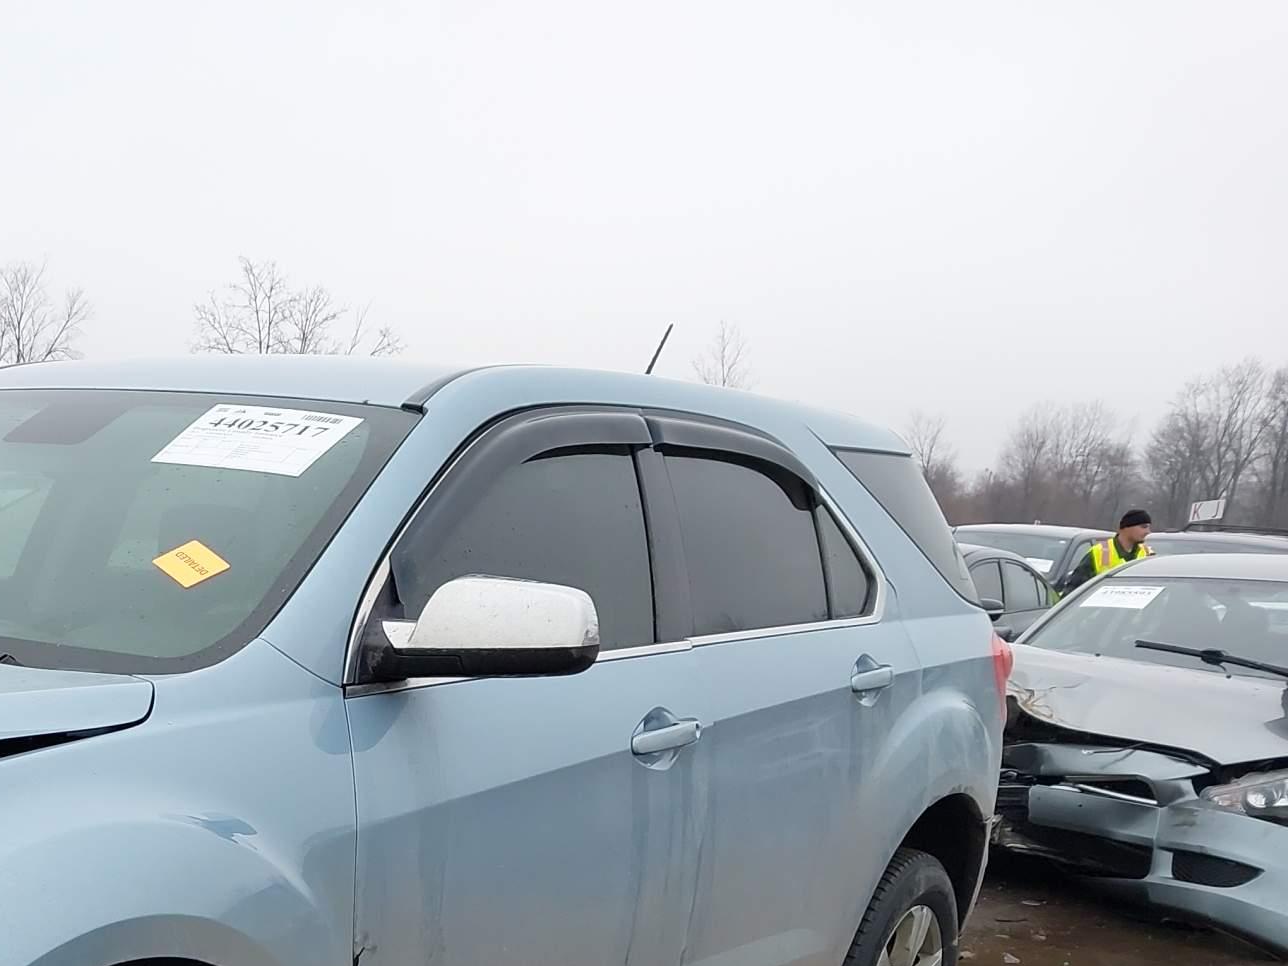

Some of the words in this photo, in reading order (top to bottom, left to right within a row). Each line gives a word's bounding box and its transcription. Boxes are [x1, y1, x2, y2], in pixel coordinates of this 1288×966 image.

[209, 416, 331, 438] 44025717
[1192, 503, 1203, 521] K
[175, 551, 209, 576] DETAILED
